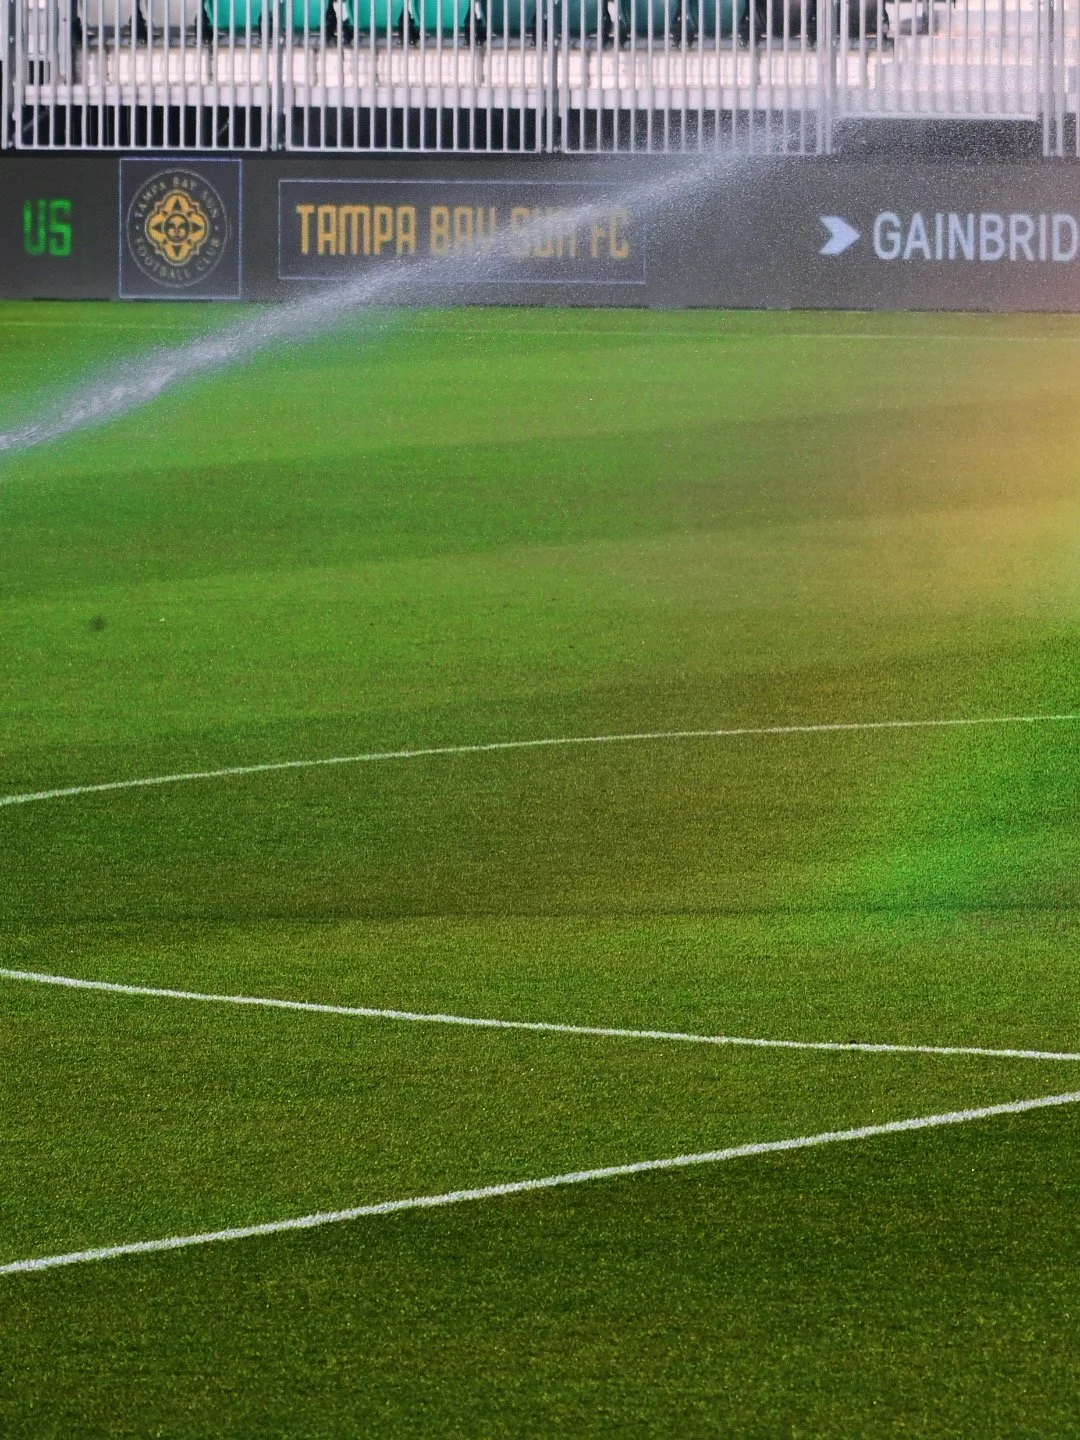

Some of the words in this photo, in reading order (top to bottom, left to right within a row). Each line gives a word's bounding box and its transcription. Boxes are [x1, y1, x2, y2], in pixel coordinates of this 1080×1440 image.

[22, 199, 73, 257] US
[295, 203, 416, 256] TAMPA
[429, 205, 497, 258] BAY
